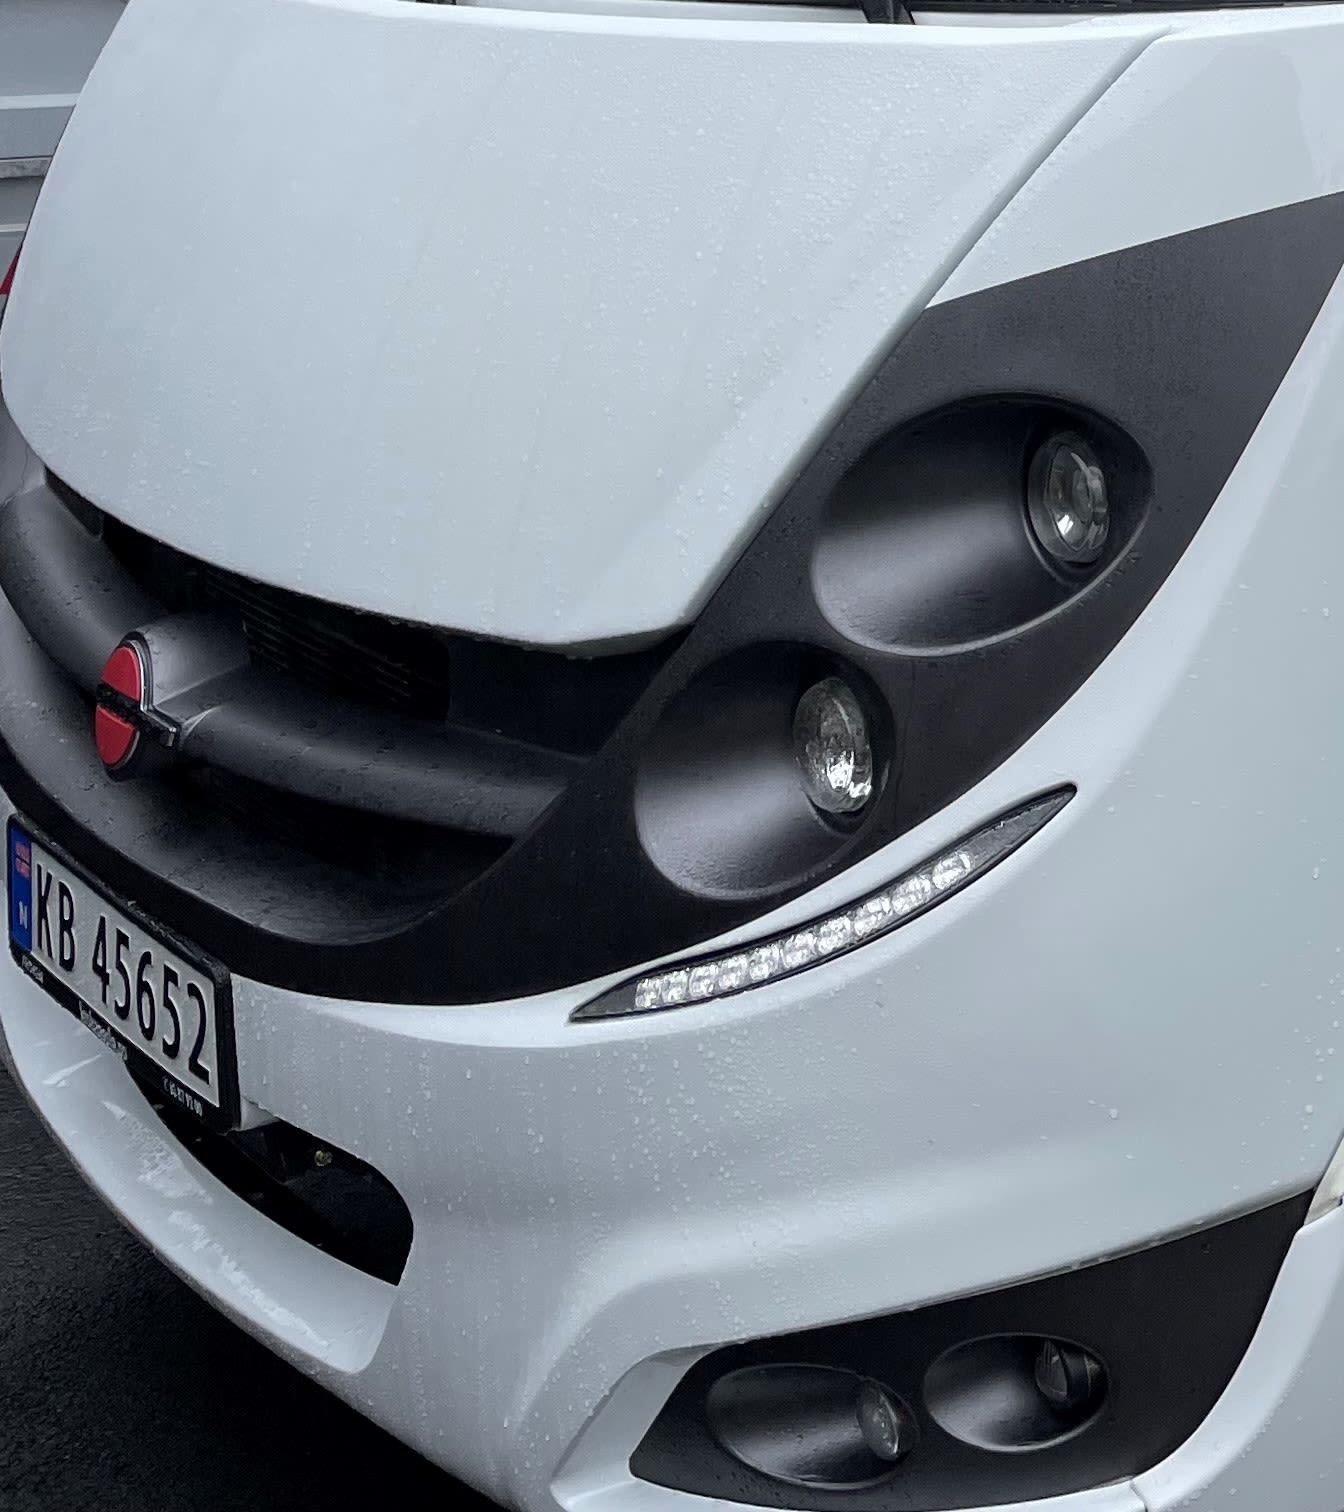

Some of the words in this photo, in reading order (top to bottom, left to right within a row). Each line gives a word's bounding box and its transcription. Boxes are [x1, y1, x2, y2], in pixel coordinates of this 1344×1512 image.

[19, 900, 28, 929] N
[37, 863, 76, 972] KB
[92, 915, 211, 1085] 45652
